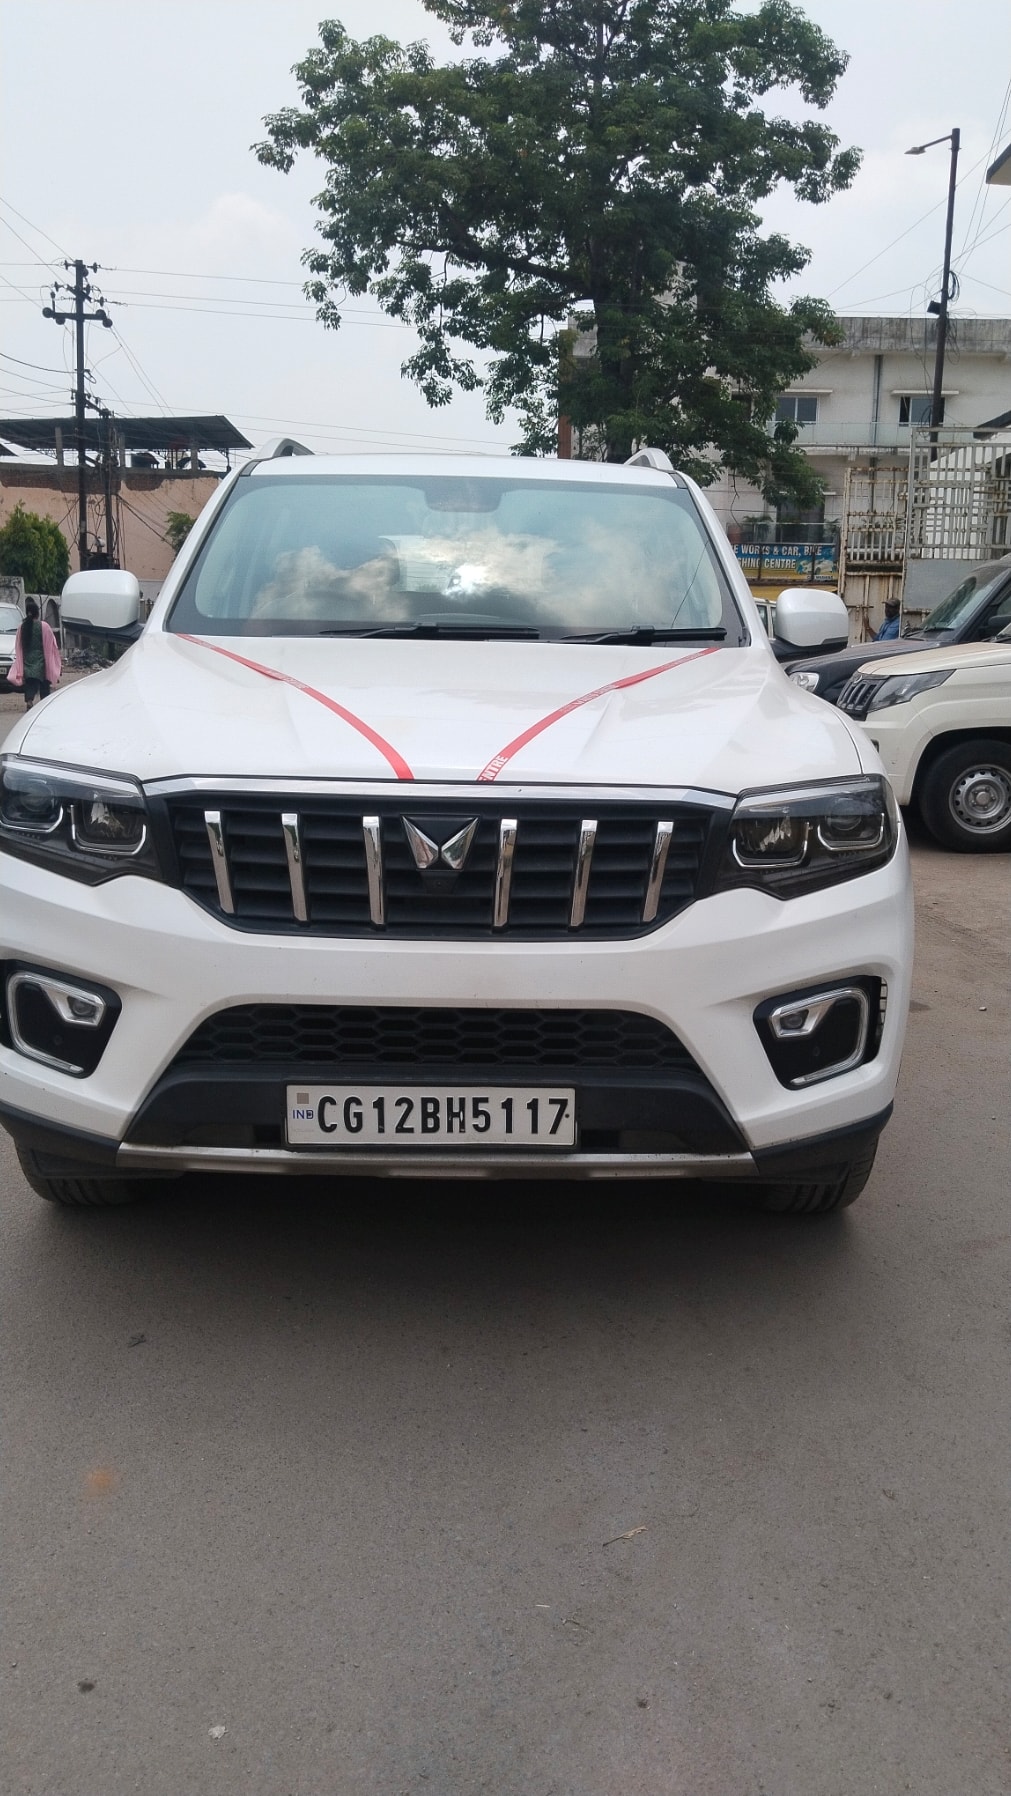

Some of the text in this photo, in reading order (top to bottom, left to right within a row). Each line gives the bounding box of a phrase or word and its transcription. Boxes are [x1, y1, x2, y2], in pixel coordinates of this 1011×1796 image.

[741, 544, 771, 555] WORKS
[773, 545, 780, 555] &
[781, 545, 802, 557] CAR,
[764, 558, 796, 569] CENTRE
[317, 1095, 569, 1135] CG12BH5117
